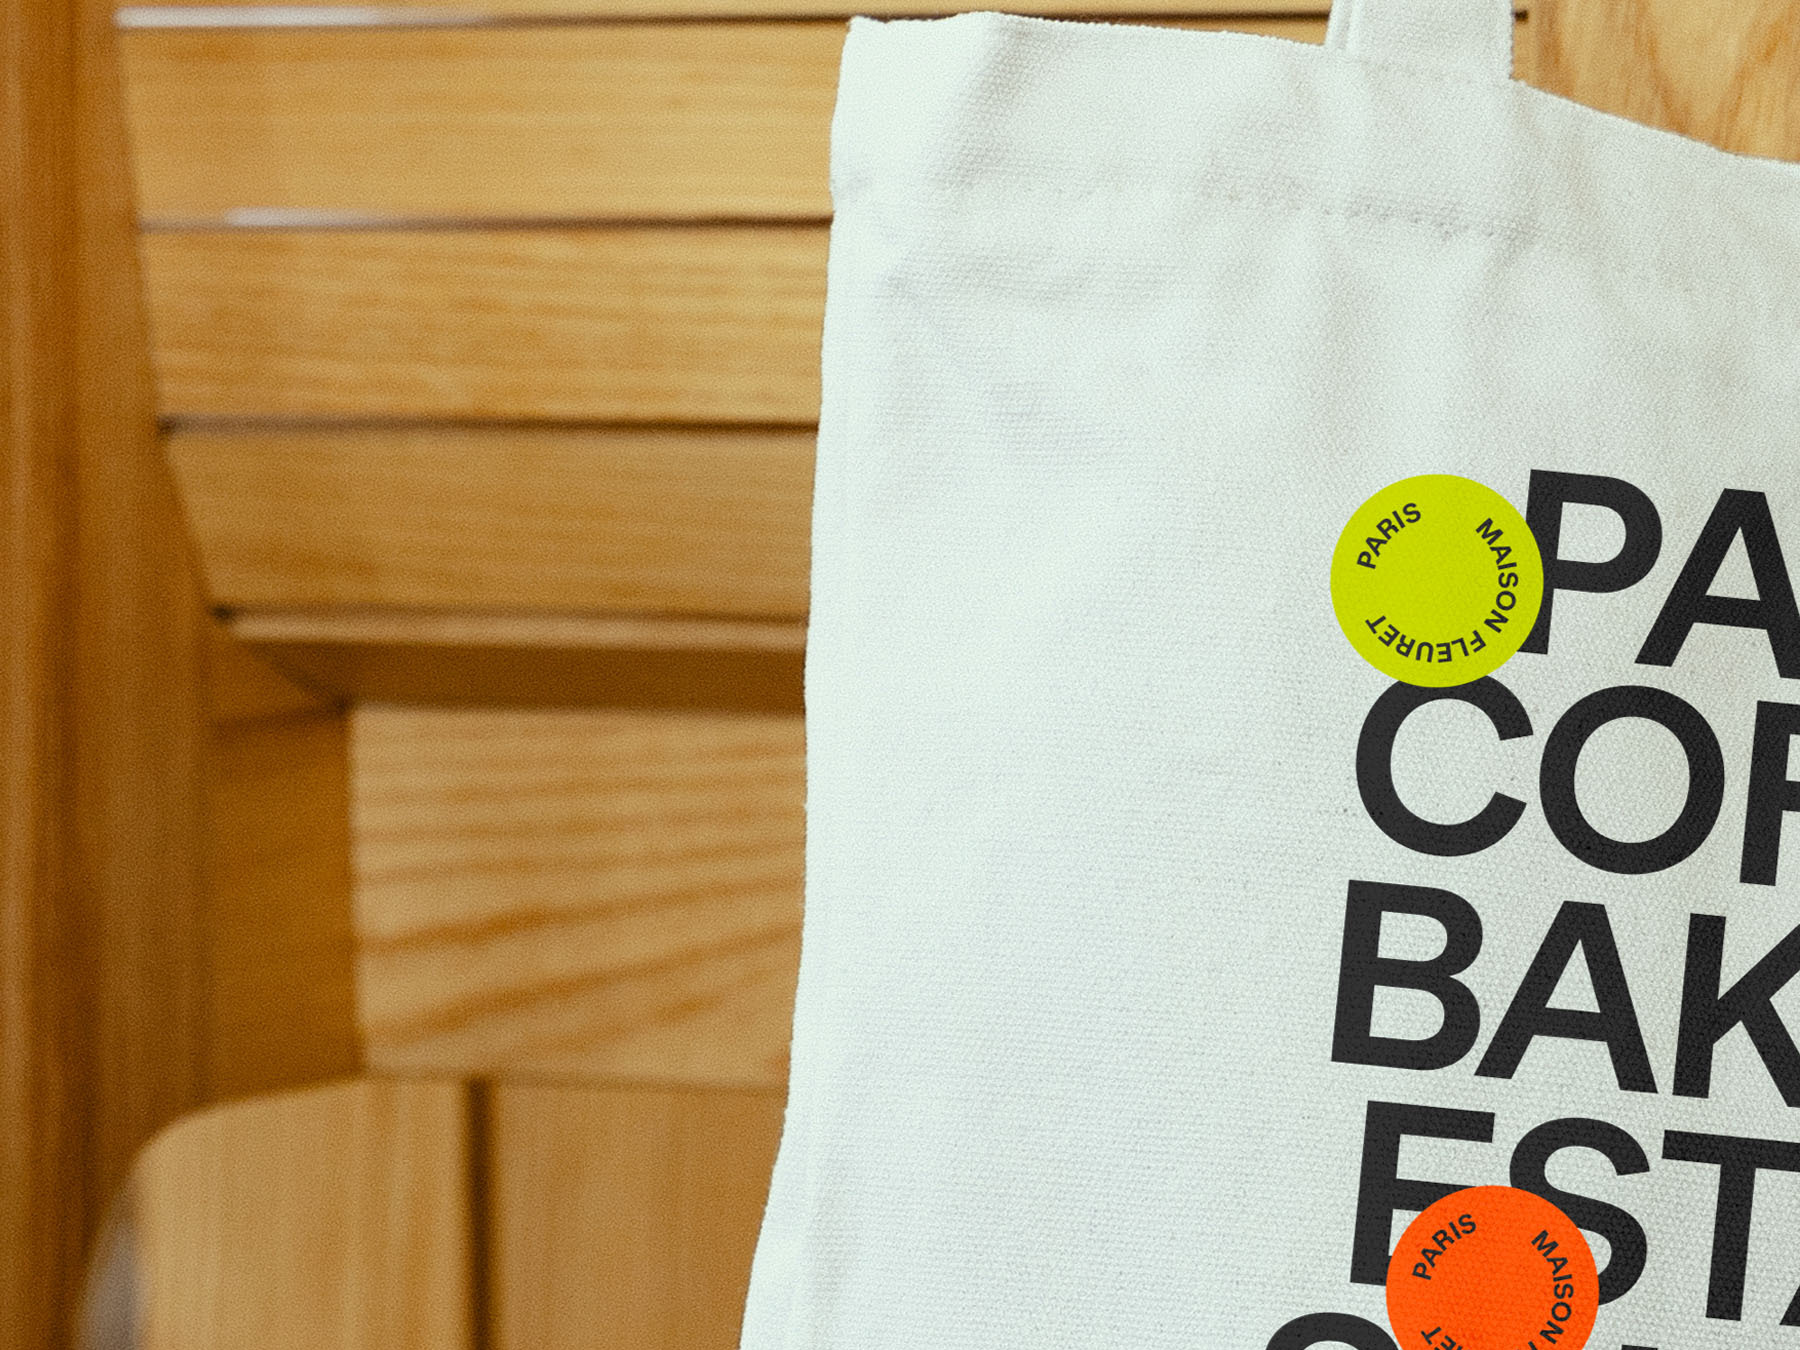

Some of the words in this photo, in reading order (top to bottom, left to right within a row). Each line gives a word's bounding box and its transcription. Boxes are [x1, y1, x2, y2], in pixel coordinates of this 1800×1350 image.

[1356, 502, 1421, 569] PARIS
[1475, 517, 1518, 634] MAISON
[1365, 615, 1487, 663] FLEURET
[1412, 1214, 1477, 1281] PARIS
[1531, 1229, 1574, 1345] MAISON
